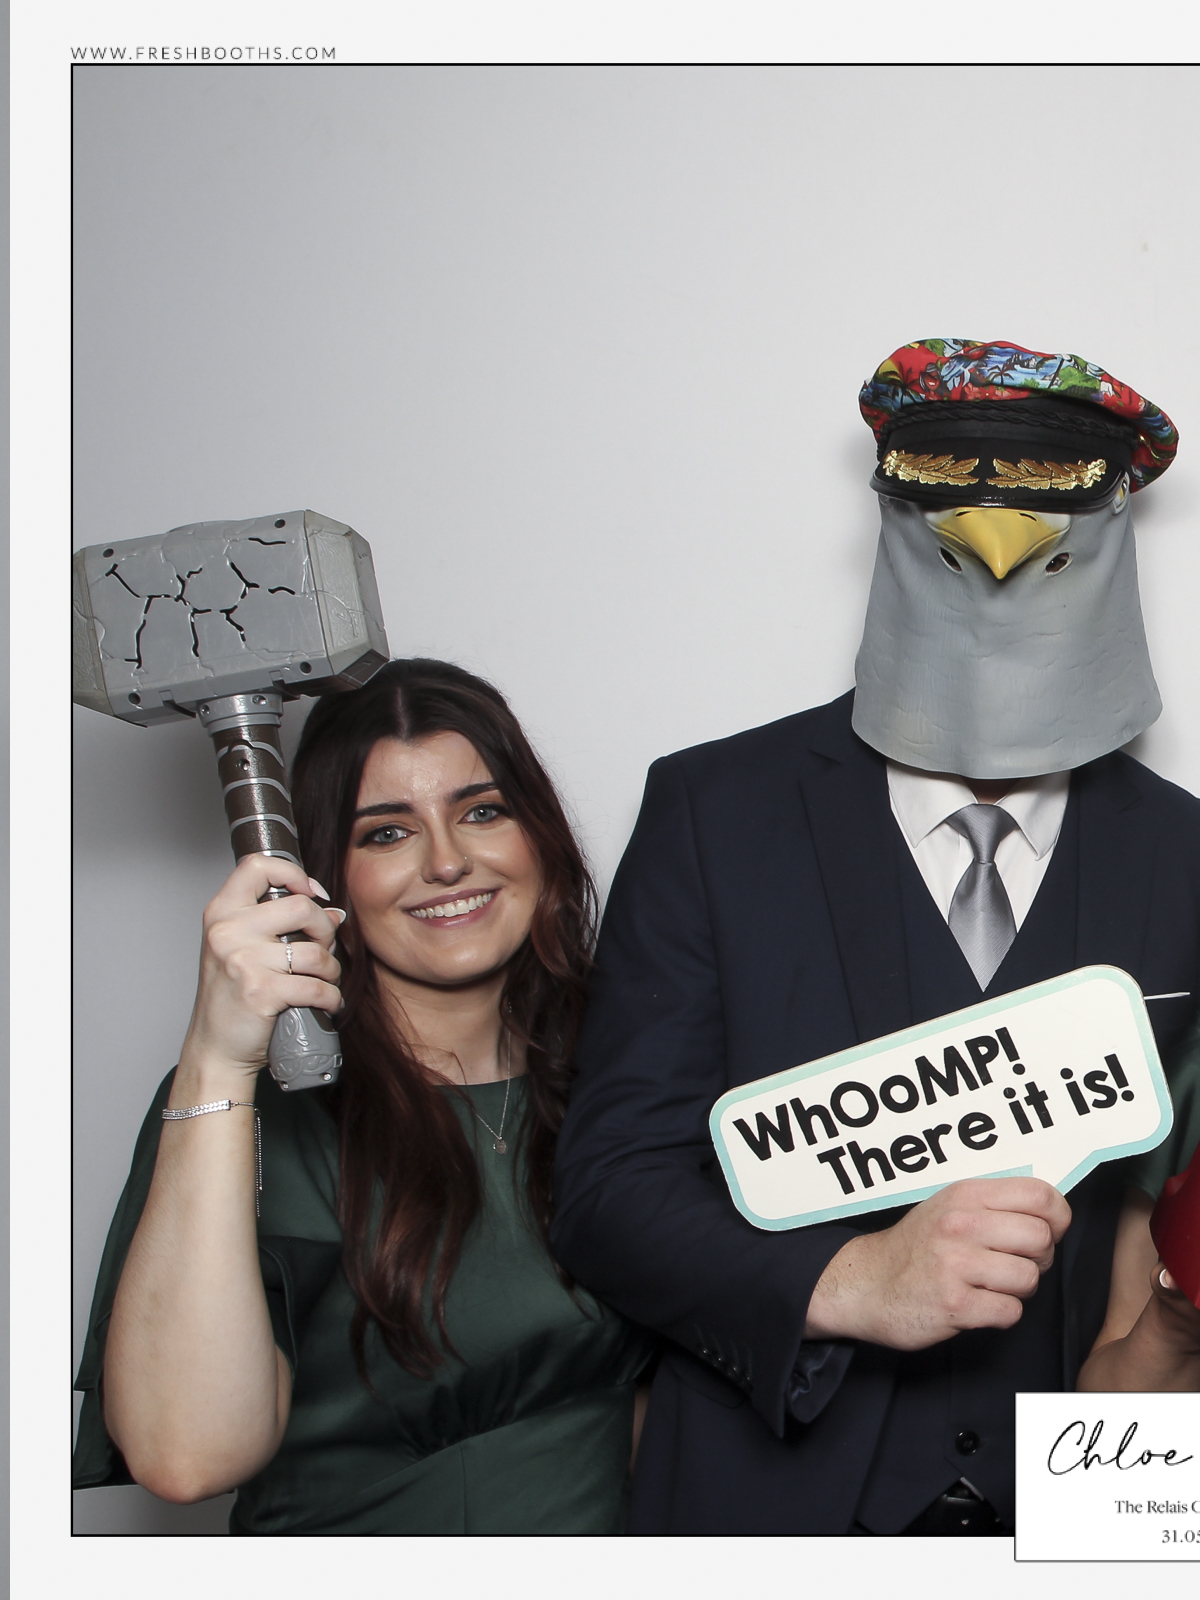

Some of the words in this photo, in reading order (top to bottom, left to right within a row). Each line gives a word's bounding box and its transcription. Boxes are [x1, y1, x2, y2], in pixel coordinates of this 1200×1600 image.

[817, 1113, 998, 1194] There
[1004, 1082, 1053, 1134] it
[1061, 1054, 1134, 1115] is!
